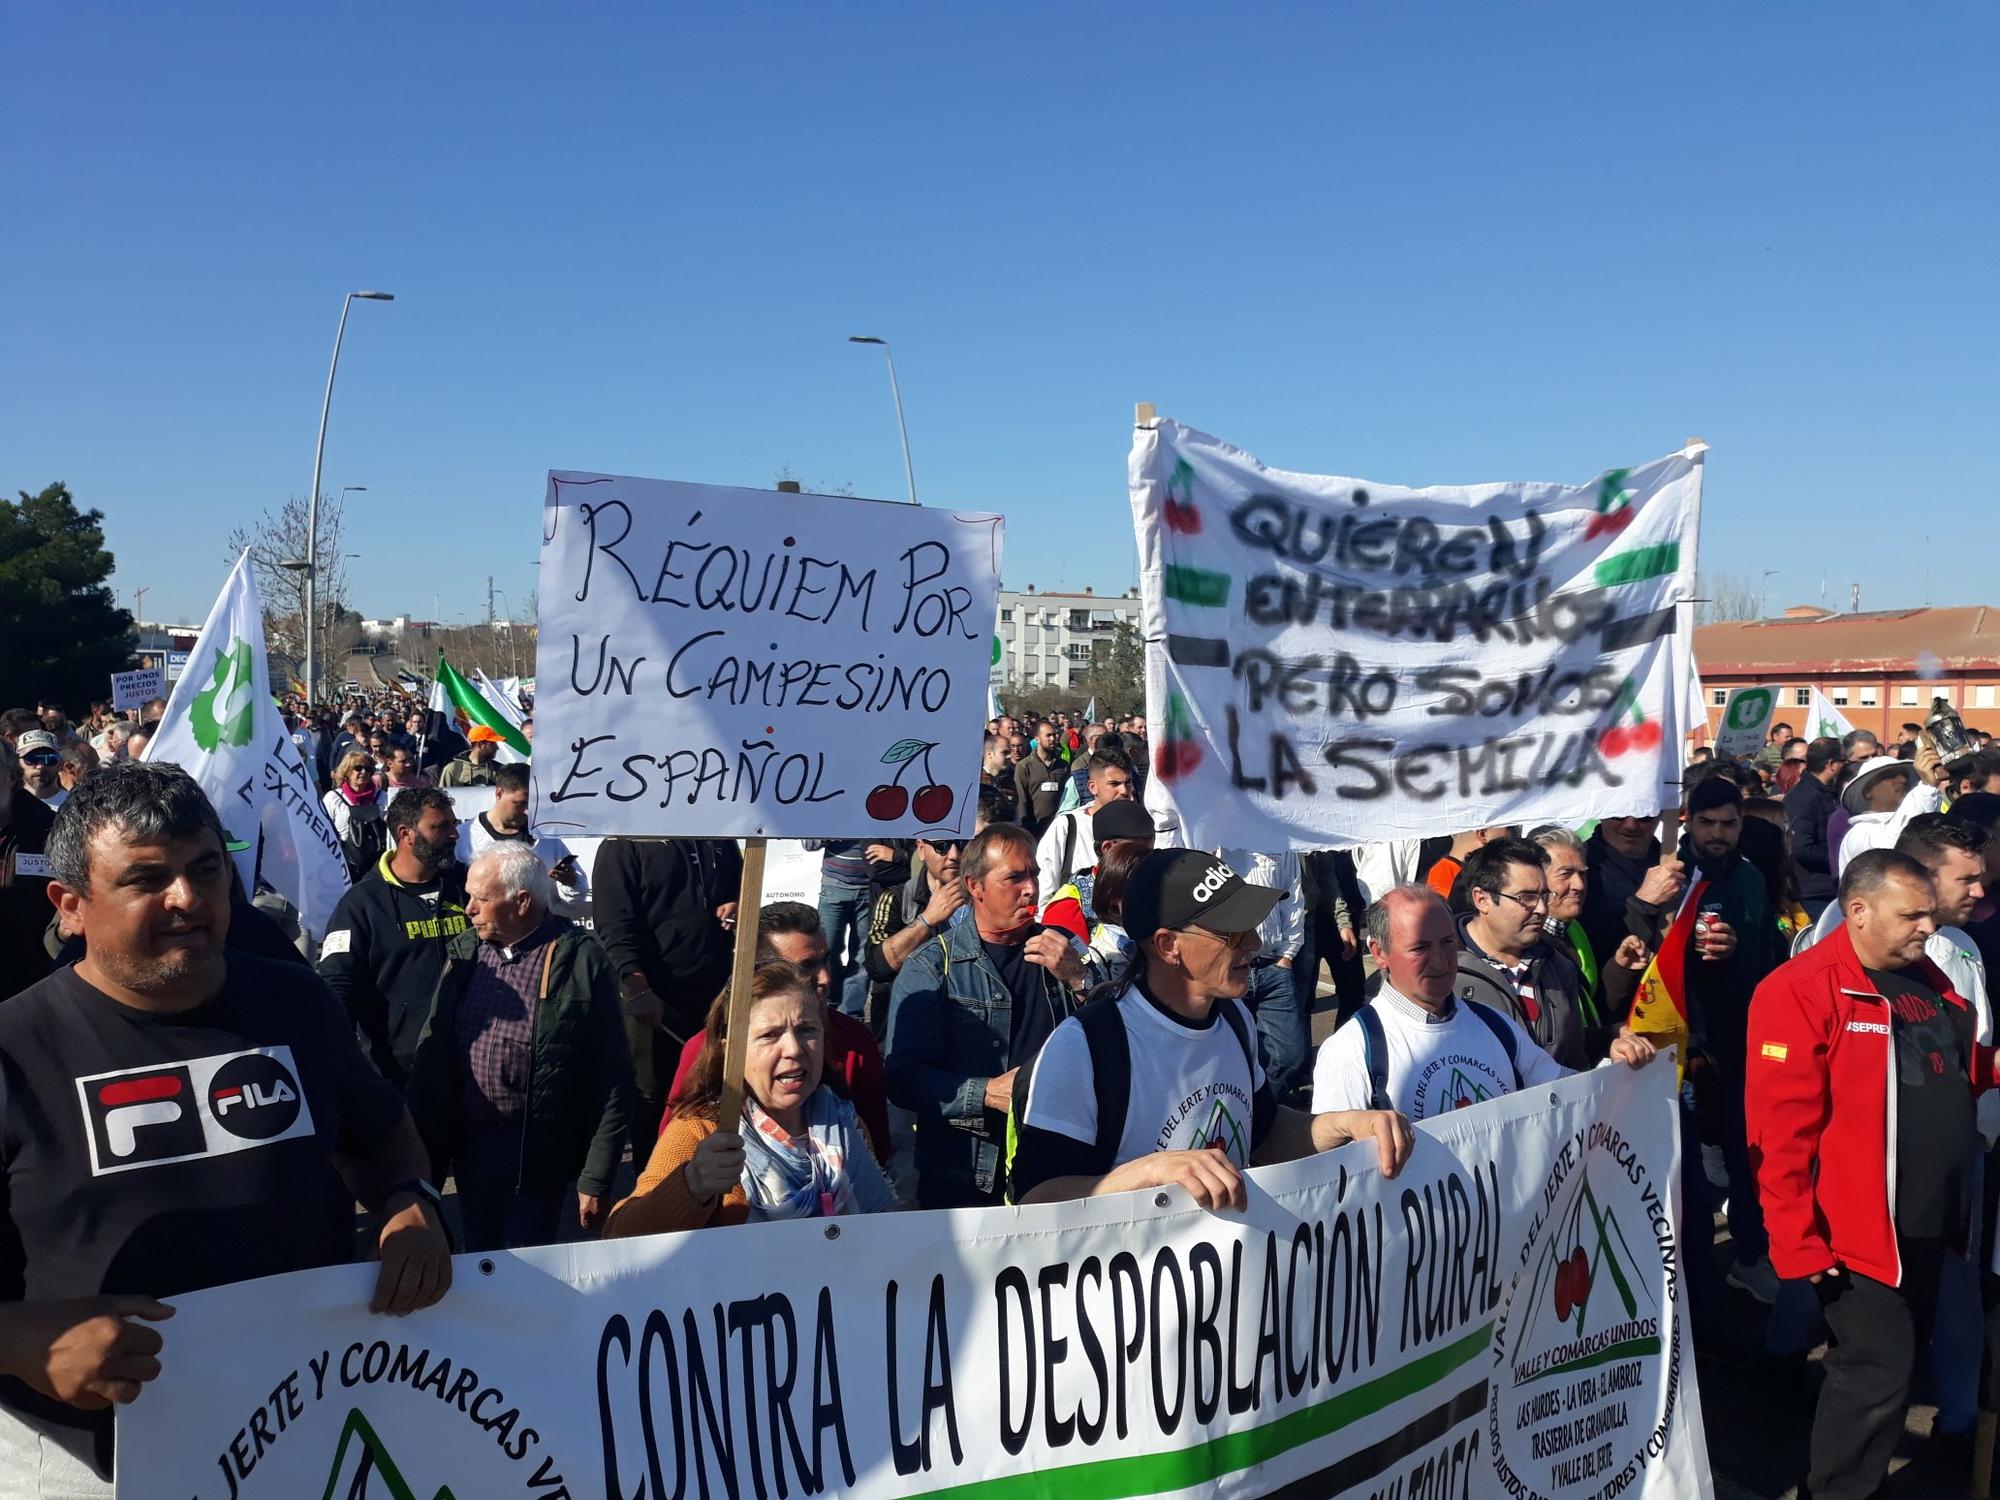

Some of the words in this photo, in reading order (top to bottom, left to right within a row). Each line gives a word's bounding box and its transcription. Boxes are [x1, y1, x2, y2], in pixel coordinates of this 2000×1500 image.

[1230, 489, 1547, 579] QUIEREN
[120, 680, 157, 691] PRECIOS
[125, 688, 157, 698] JUSTOS
[136, 671, 160, 680] UNOS
[1234, 650, 1397, 718] PERO
[1417, 664, 1620, 717] SOMOS
[550, 735, 846, 808] ESPAÑOL
[1226, 704, 1317, 801] LA
[1323, 725, 1624, 802] SEMILLA
[1192, 861, 1235, 903] adid
[405, 915, 467, 940] PUMA
[214, 1079, 296, 1116] FILA
[1415, 1080, 1428, 1099] DEL
[1422, 1060, 1441, 1083] JERTE
[1440, 1057, 1446, 1067] Y
[1448, 1055, 1496, 1078] COMARCAS
[1161, 1115, 1180, 1139] DEL
[1178, 1089, 1204, 1120] JERTE
[1204, 1085, 1211, 1097] Y
[1494, 1271, 1521, 1368] VALLE
[1520, 1212, 1545, 1267] DEL
[1544, 1140, 1576, 1219] JERTE
[1575, 1128, 1585, 1158] Y
[1640, 1182, 1680, 1304] VECINAS
[597, 1286, 856, 1500] CONTRA
[886, 1274, 963, 1476] LA
[995, 1165, 1382, 1455] DESPOBLACIÓN
[1400, 1160, 1503, 1352] RURAL
[1514, 1354, 1543, 1384] VALLE
[1543, 1349, 1551, 1370] Y
[1552, 1330, 1609, 1366] COMARCAS
[1611, 1317, 1658, 1347] UNIDOS
[218, 1369, 304, 1500] JERTE
[308, 1350, 330, 1401] Y
[339, 1340, 540, 1460] COMARCAS
[1489, 1384, 1502, 1457] PRECIOS
[1516, 1401, 1531, 1430] LAS
[1531, 1388, 1560, 1427] HURDES
[1566, 1384, 1577, 1412] LA
[1577, 1377, 1597, 1407] VERA
[1600, 1372, 1607, 1398] EL
[1608, 1361, 1642, 1394] AMBROZ
[1635, 1448, 1647, 1470] Y
[1647, 1314, 1681, 1459] CONSUMIDORES
[1532, 1419, 1574, 1460] TRASIERRA
[1574, 1418, 1585, 1446] DE
[1585, 1401, 1628, 1441] GRANADILLA
[1493, 1455, 1528, 1500] JUSTOS
[1551, 1463, 1558, 1491] Y
[1558, 1456, 1582, 1488] VALLE
[1582, 1451, 1596, 1480] DEL
